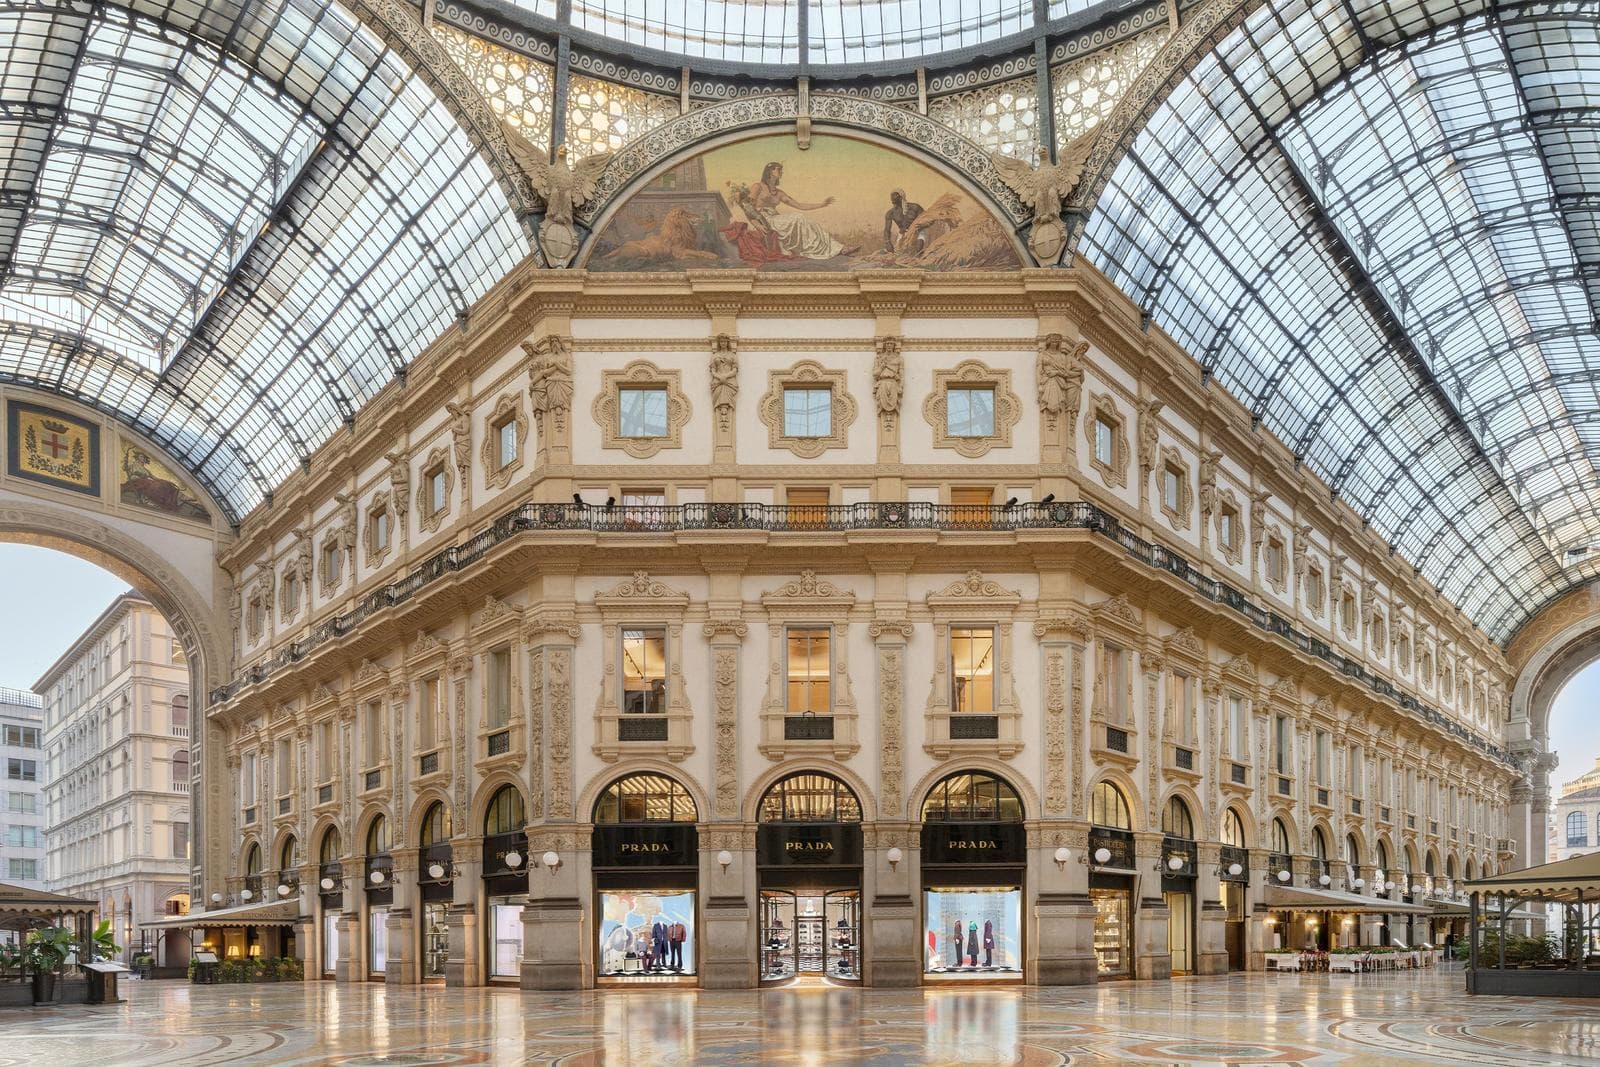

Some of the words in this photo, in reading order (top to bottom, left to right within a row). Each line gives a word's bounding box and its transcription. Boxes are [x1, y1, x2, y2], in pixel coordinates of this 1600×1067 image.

[621, 843, 670, 852] PRADA
[785, 842, 834, 850] PRADA
[949, 841, 997, 849] PRADA
